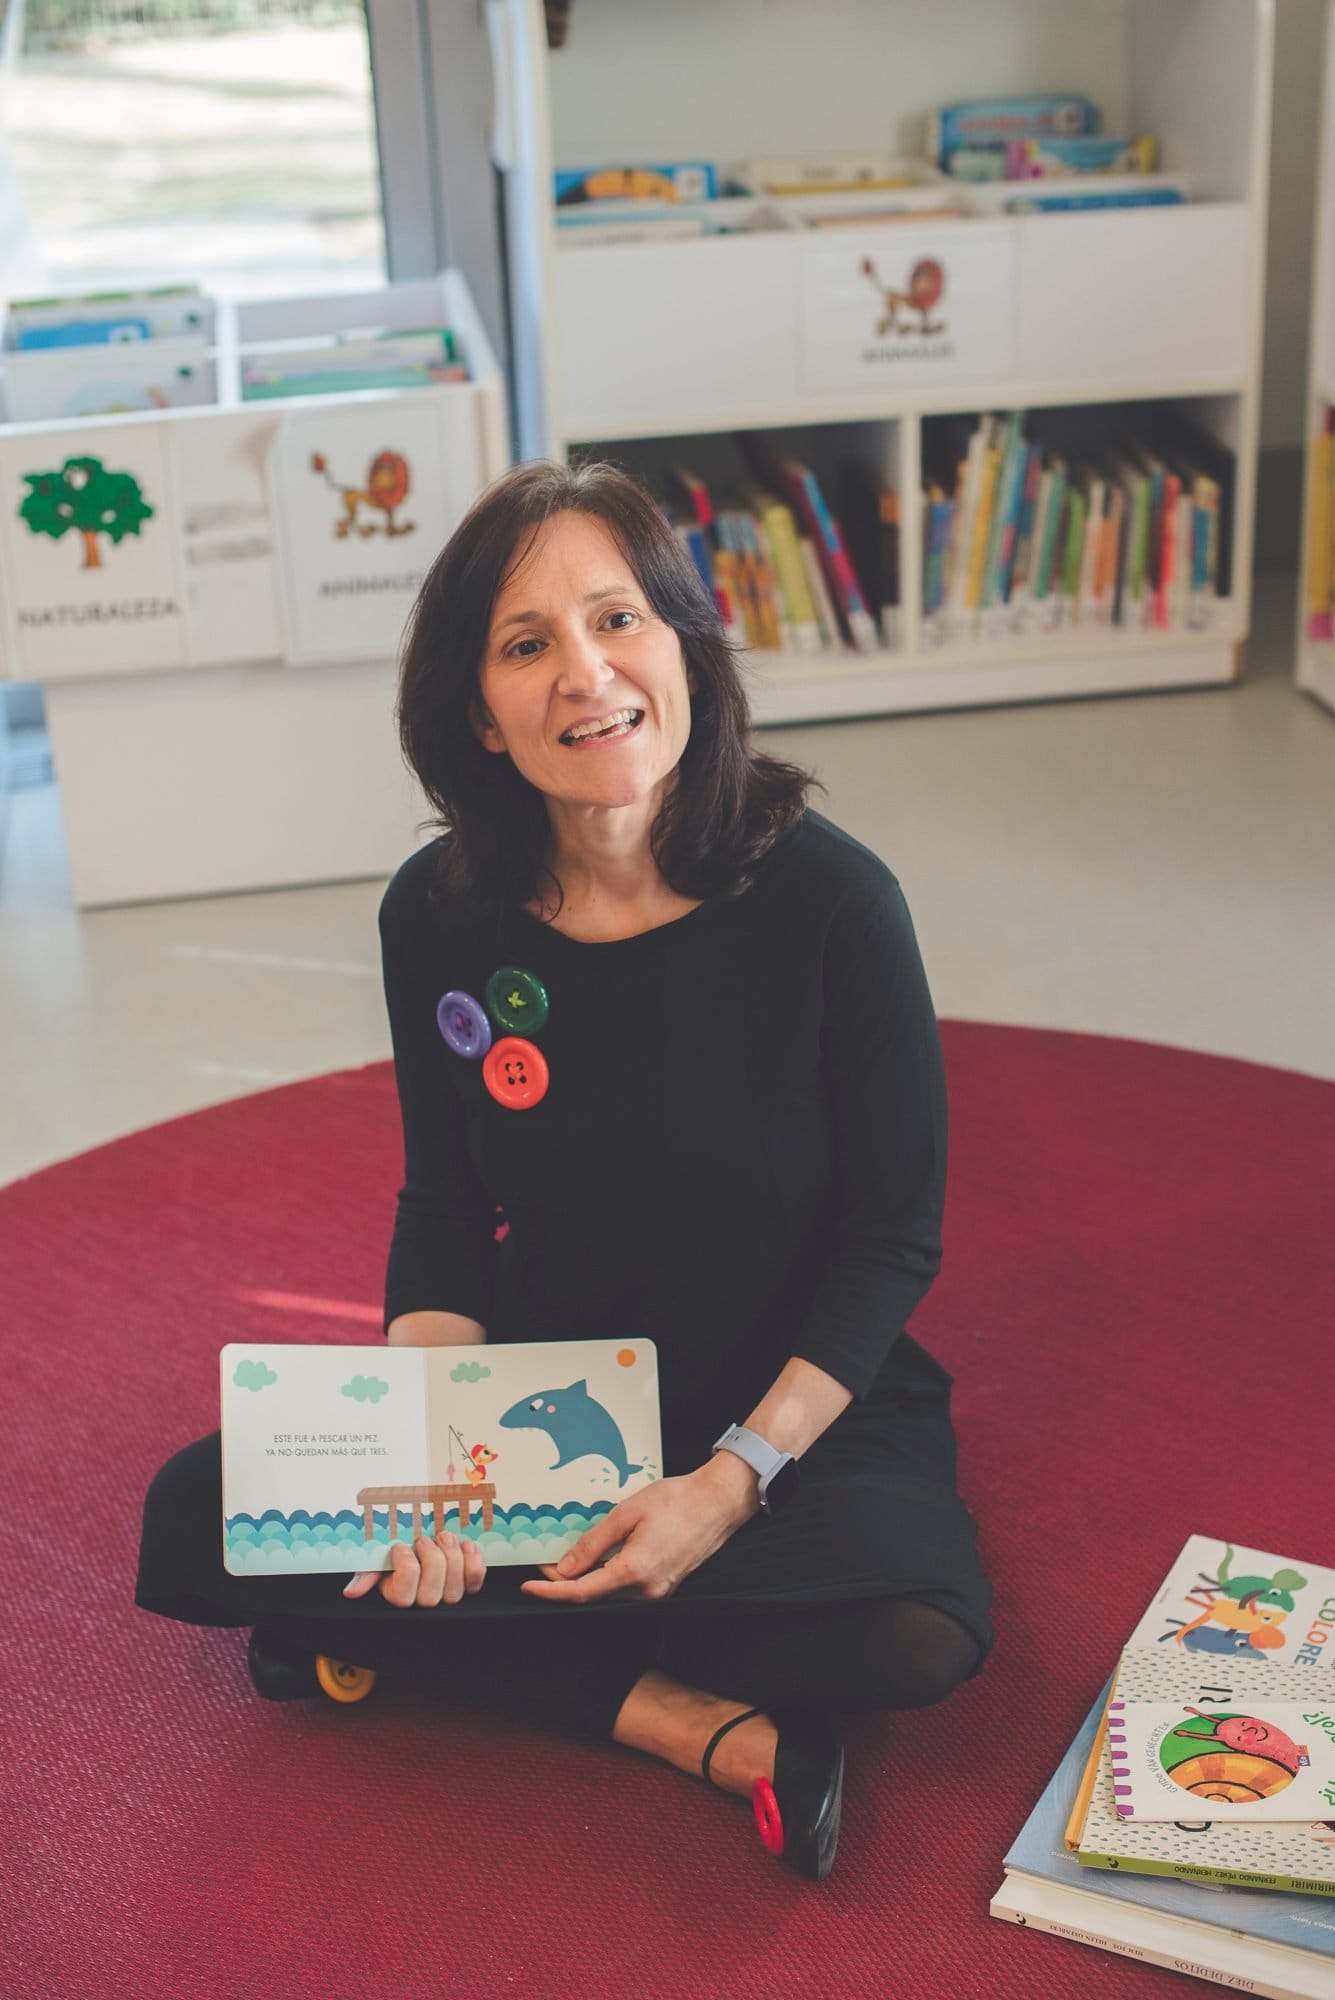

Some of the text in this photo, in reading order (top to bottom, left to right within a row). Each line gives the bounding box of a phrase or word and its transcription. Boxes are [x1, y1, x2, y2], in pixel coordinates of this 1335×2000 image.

[17, 597, 180, 627] NATURALEZA
[274, 1434, 292, 1443] ESTE
[294, 1434, 308, 1443] FUE
[311, 1434, 317, 1443] A
[319, 1434, 347, 1443] PESCAR
[349, 1434, 362, 1443] UN
[265, 1447, 276, 1456] YA
[278, 1447, 292, 1456] NO
[294, 1447, 329, 1457] QUEDAN
[331, 1445, 348, 1456] MÁS
[350, 1447, 367, 1457] QUE
[1145, 1721, 1171, 1757] GENECHTEN
[1146, 1759, 1159, 1773] VAN
[1174, 1866, 1212, 1877] HERNANDO
[1215, 1871, 1236, 1881] PÉREZ
[1239, 1874, 1277, 1885] FERNANDO
[1086, 1935, 1107, 1945] HELEN
[1113, 1943, 1144, 1957] MEM FOX
[1174, 1960, 1254, 1991] DIEZ DEDITOS
